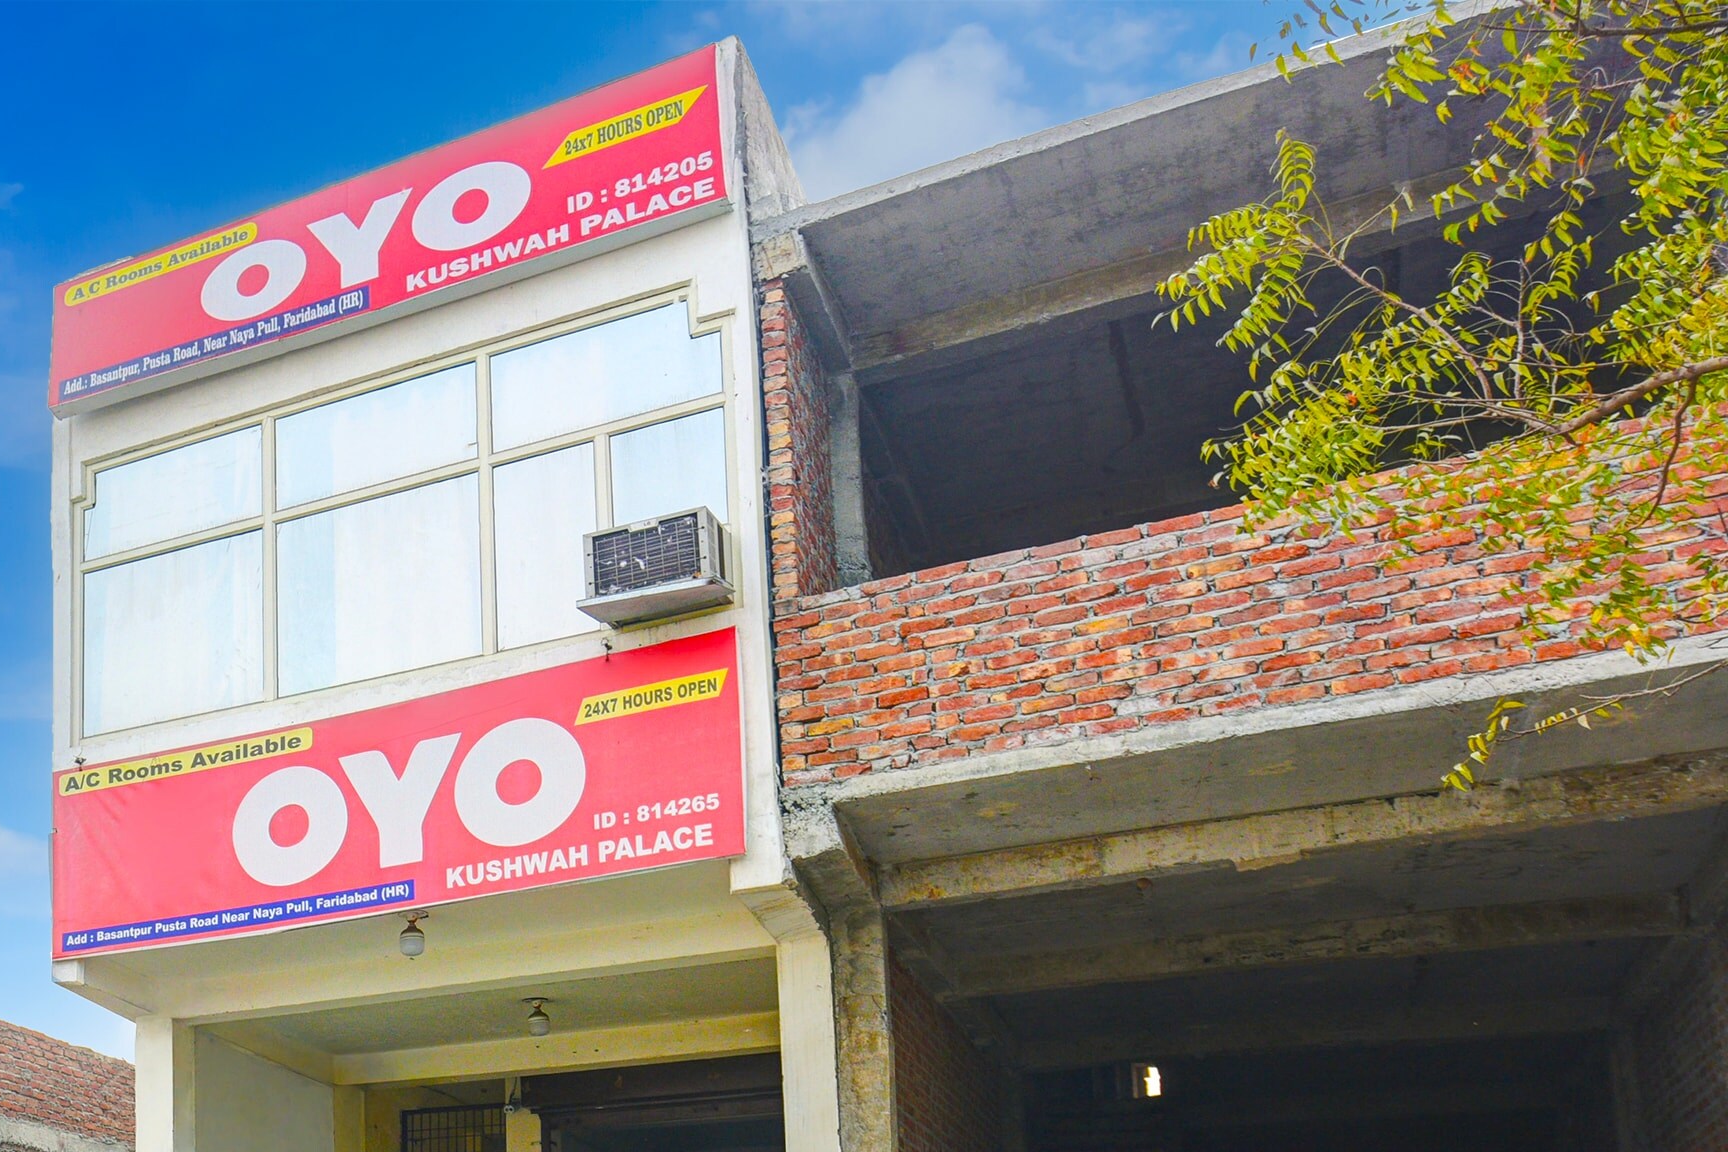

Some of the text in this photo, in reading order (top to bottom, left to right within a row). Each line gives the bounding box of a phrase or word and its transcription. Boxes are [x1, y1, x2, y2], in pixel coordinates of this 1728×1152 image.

[564, 99, 684, 155] 24x7 HOURS OPEN
[567, 191, 593, 214] ID
[614, 150, 713, 198] 814205
[105, 261, 163, 288] Rooms
[167, 229, 249, 267] Available
[200, 161, 532, 322] OYO
[406, 177, 715, 293] KUSHWAH PALACE
[142, 352, 171, 372] Pusta
[203, 335, 228, 352] Near
[229, 327, 255, 345] Naya
[283, 303, 336, 328] Faridabad
[338, 291, 364, 314] (HR)
[622, 687, 673, 710] HOURS
[677, 677, 718, 698] OPEN
[65, 735, 302, 793] A/C Rooms Available
[232, 717, 586, 887] OYO
[593, 811, 617, 830] ID
[636, 793, 720, 823] 814265
[445, 823, 714, 889] KUSHWAH PALACE
[66, 933, 88, 947] Add
[96, 924, 152, 944] Basantpur
[155, 919, 187, 934] Pusta
[190, 914, 219, 930] Road
[222, 910, 250, 926] Near
[253, 906, 284, 922] Naya
[286, 900, 313, 916] Pull,
[316, 888, 378, 909] Faridabad
[381, 883, 410, 902] (HR)
